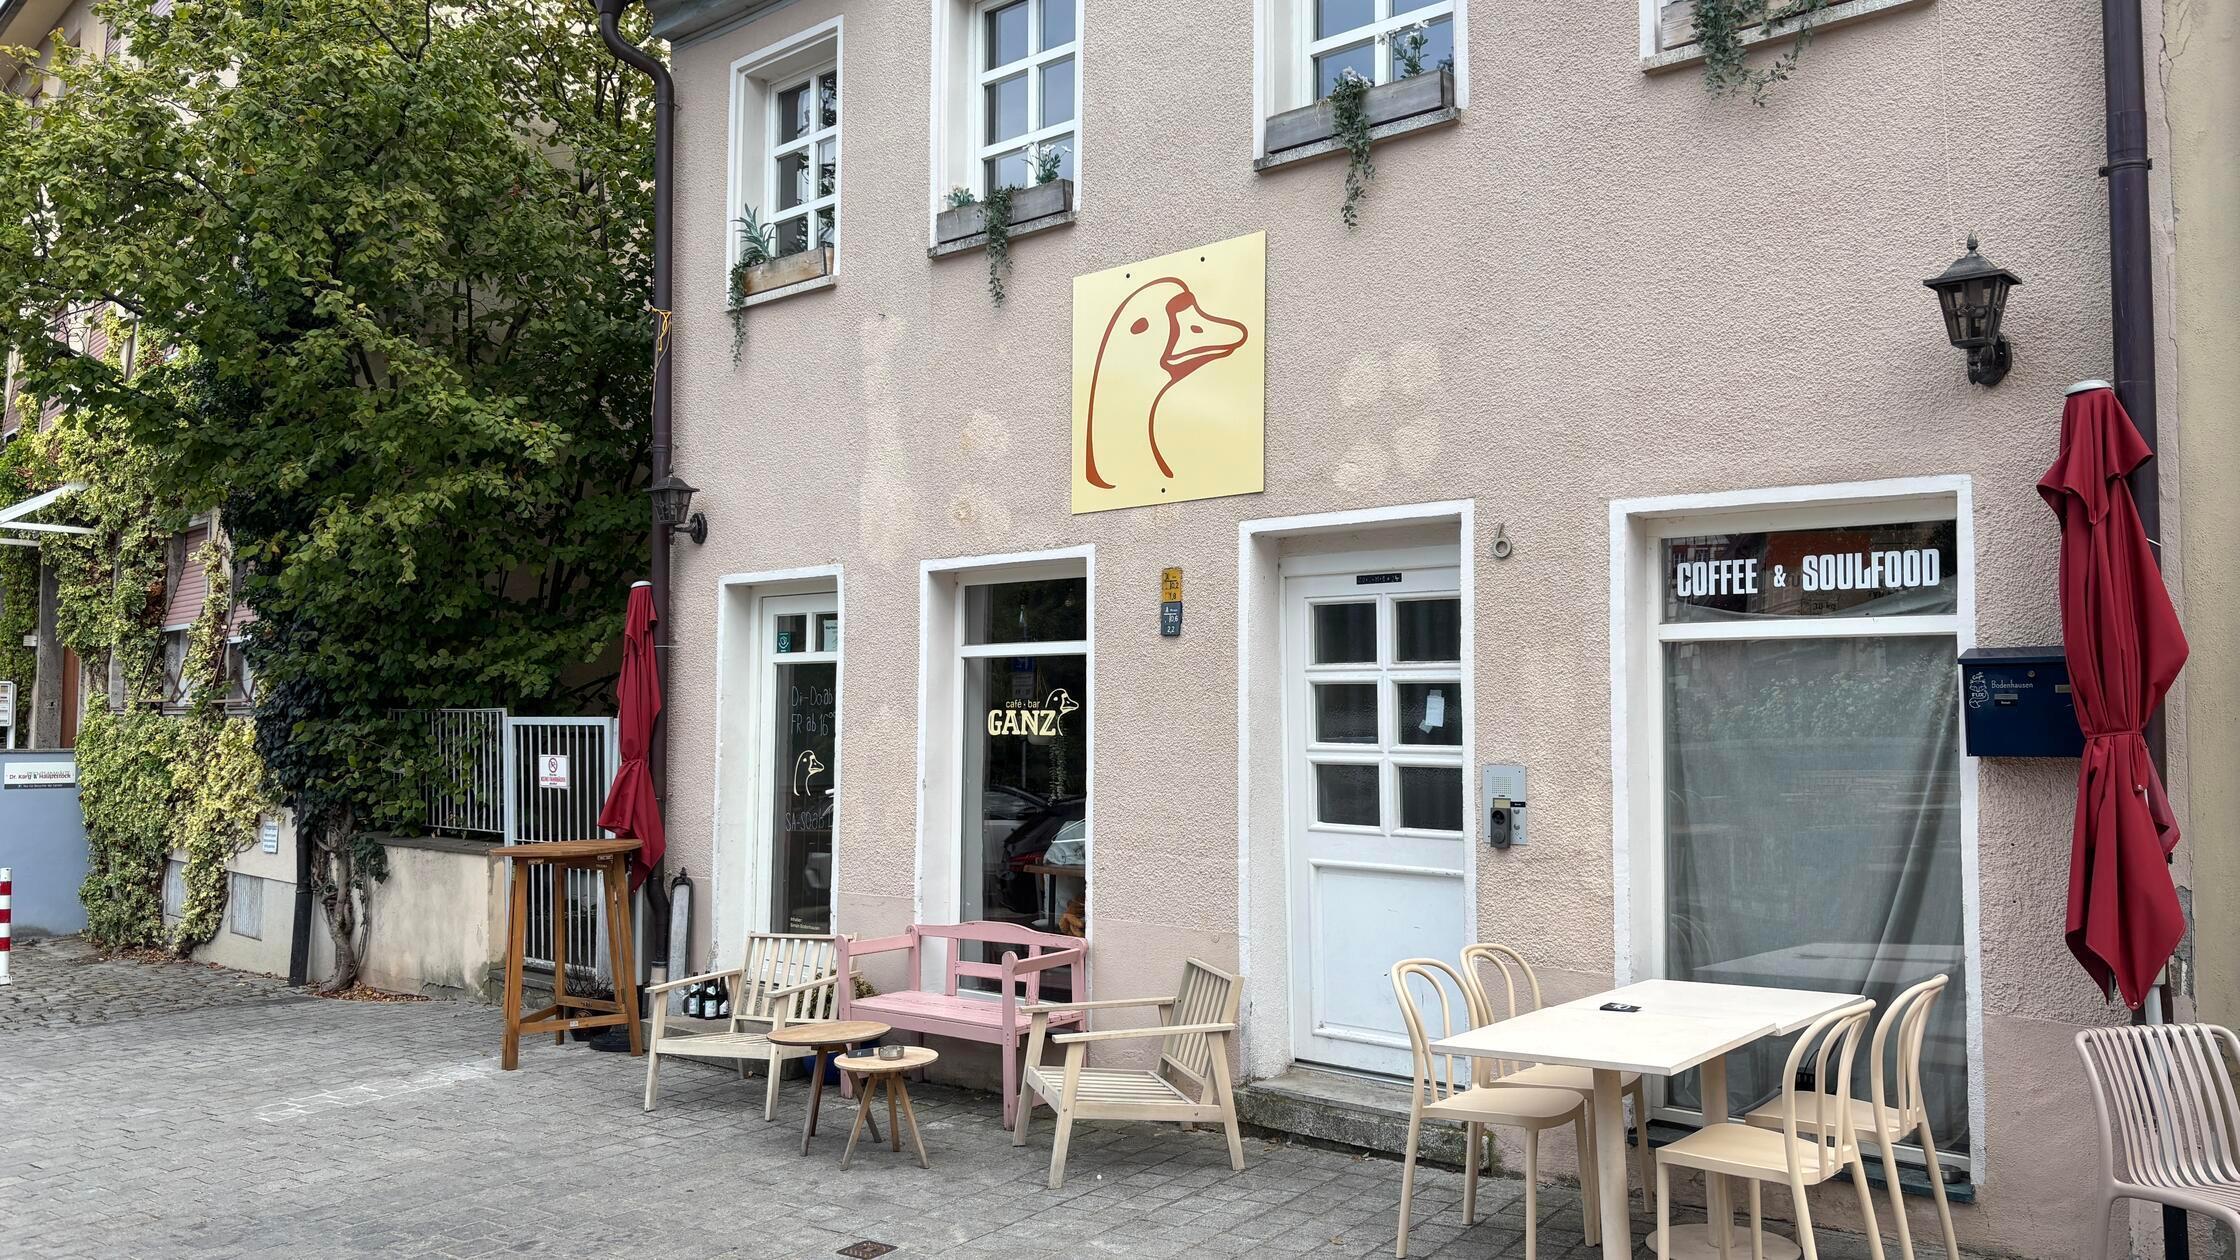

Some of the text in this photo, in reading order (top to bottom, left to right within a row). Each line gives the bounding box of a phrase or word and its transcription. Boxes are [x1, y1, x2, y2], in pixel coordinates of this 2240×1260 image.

[1493, 522, 1512, 558] 6
[1677, 548, 1941, 597] COFFEE & SOULFOOD
[1991, 680, 2033, 689] Bodenhausen
[1005, 699, 1040, 708] café bar
[806, 713, 817, 732] ab
[987, 709, 1057, 736] GANZ
